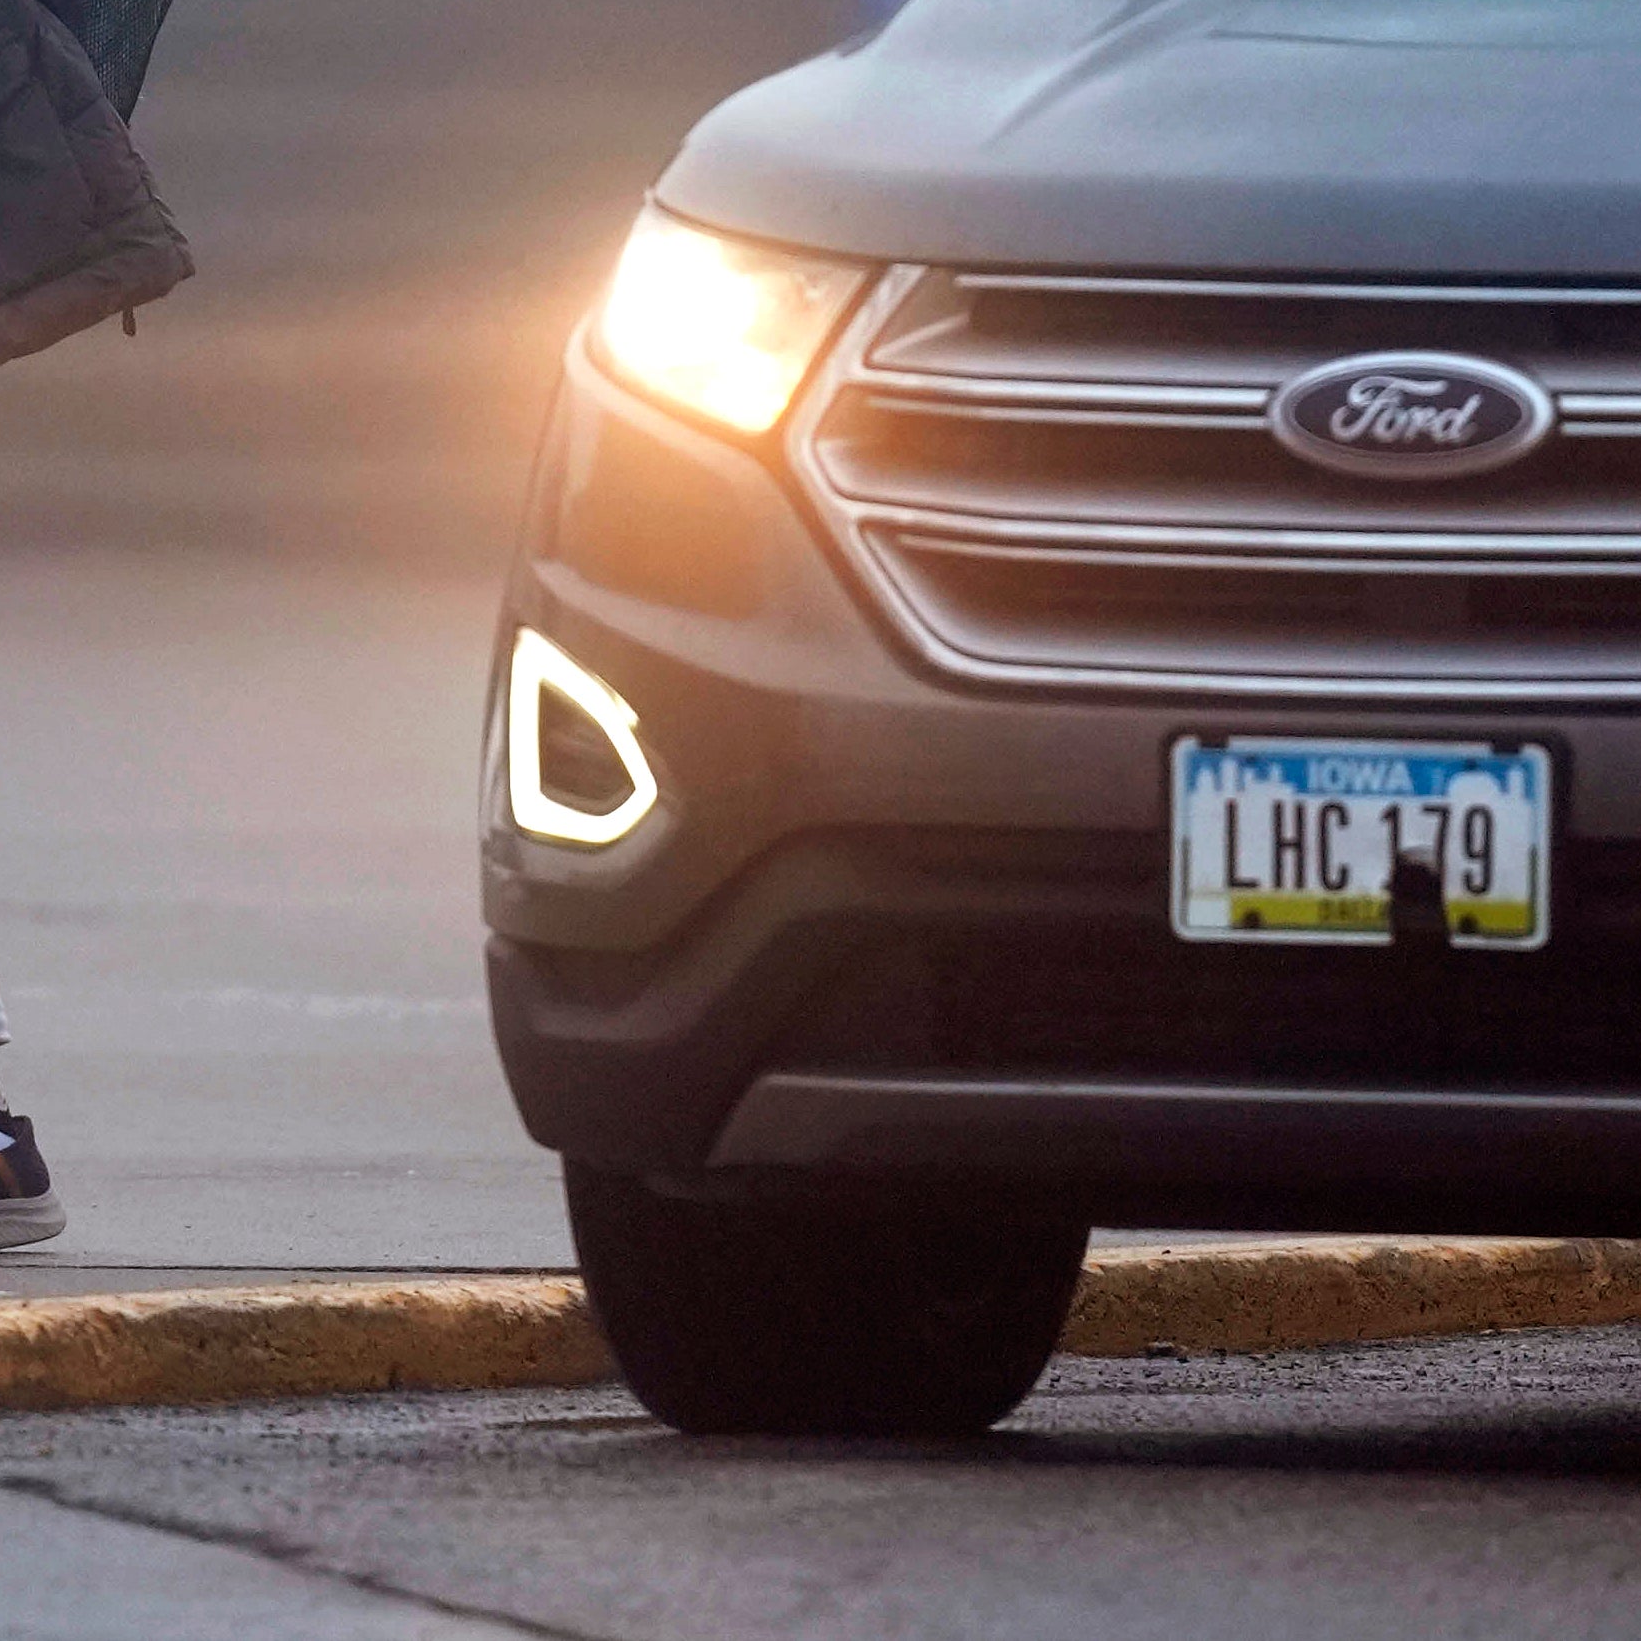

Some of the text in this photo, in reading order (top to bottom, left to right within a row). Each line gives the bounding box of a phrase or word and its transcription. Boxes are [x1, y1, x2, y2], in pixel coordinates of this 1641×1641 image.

[1330, 375, 1483, 442] Ford
[1306, 759, 1416, 795] IOWA
[1226, 797, 1494, 896] LHC 179
